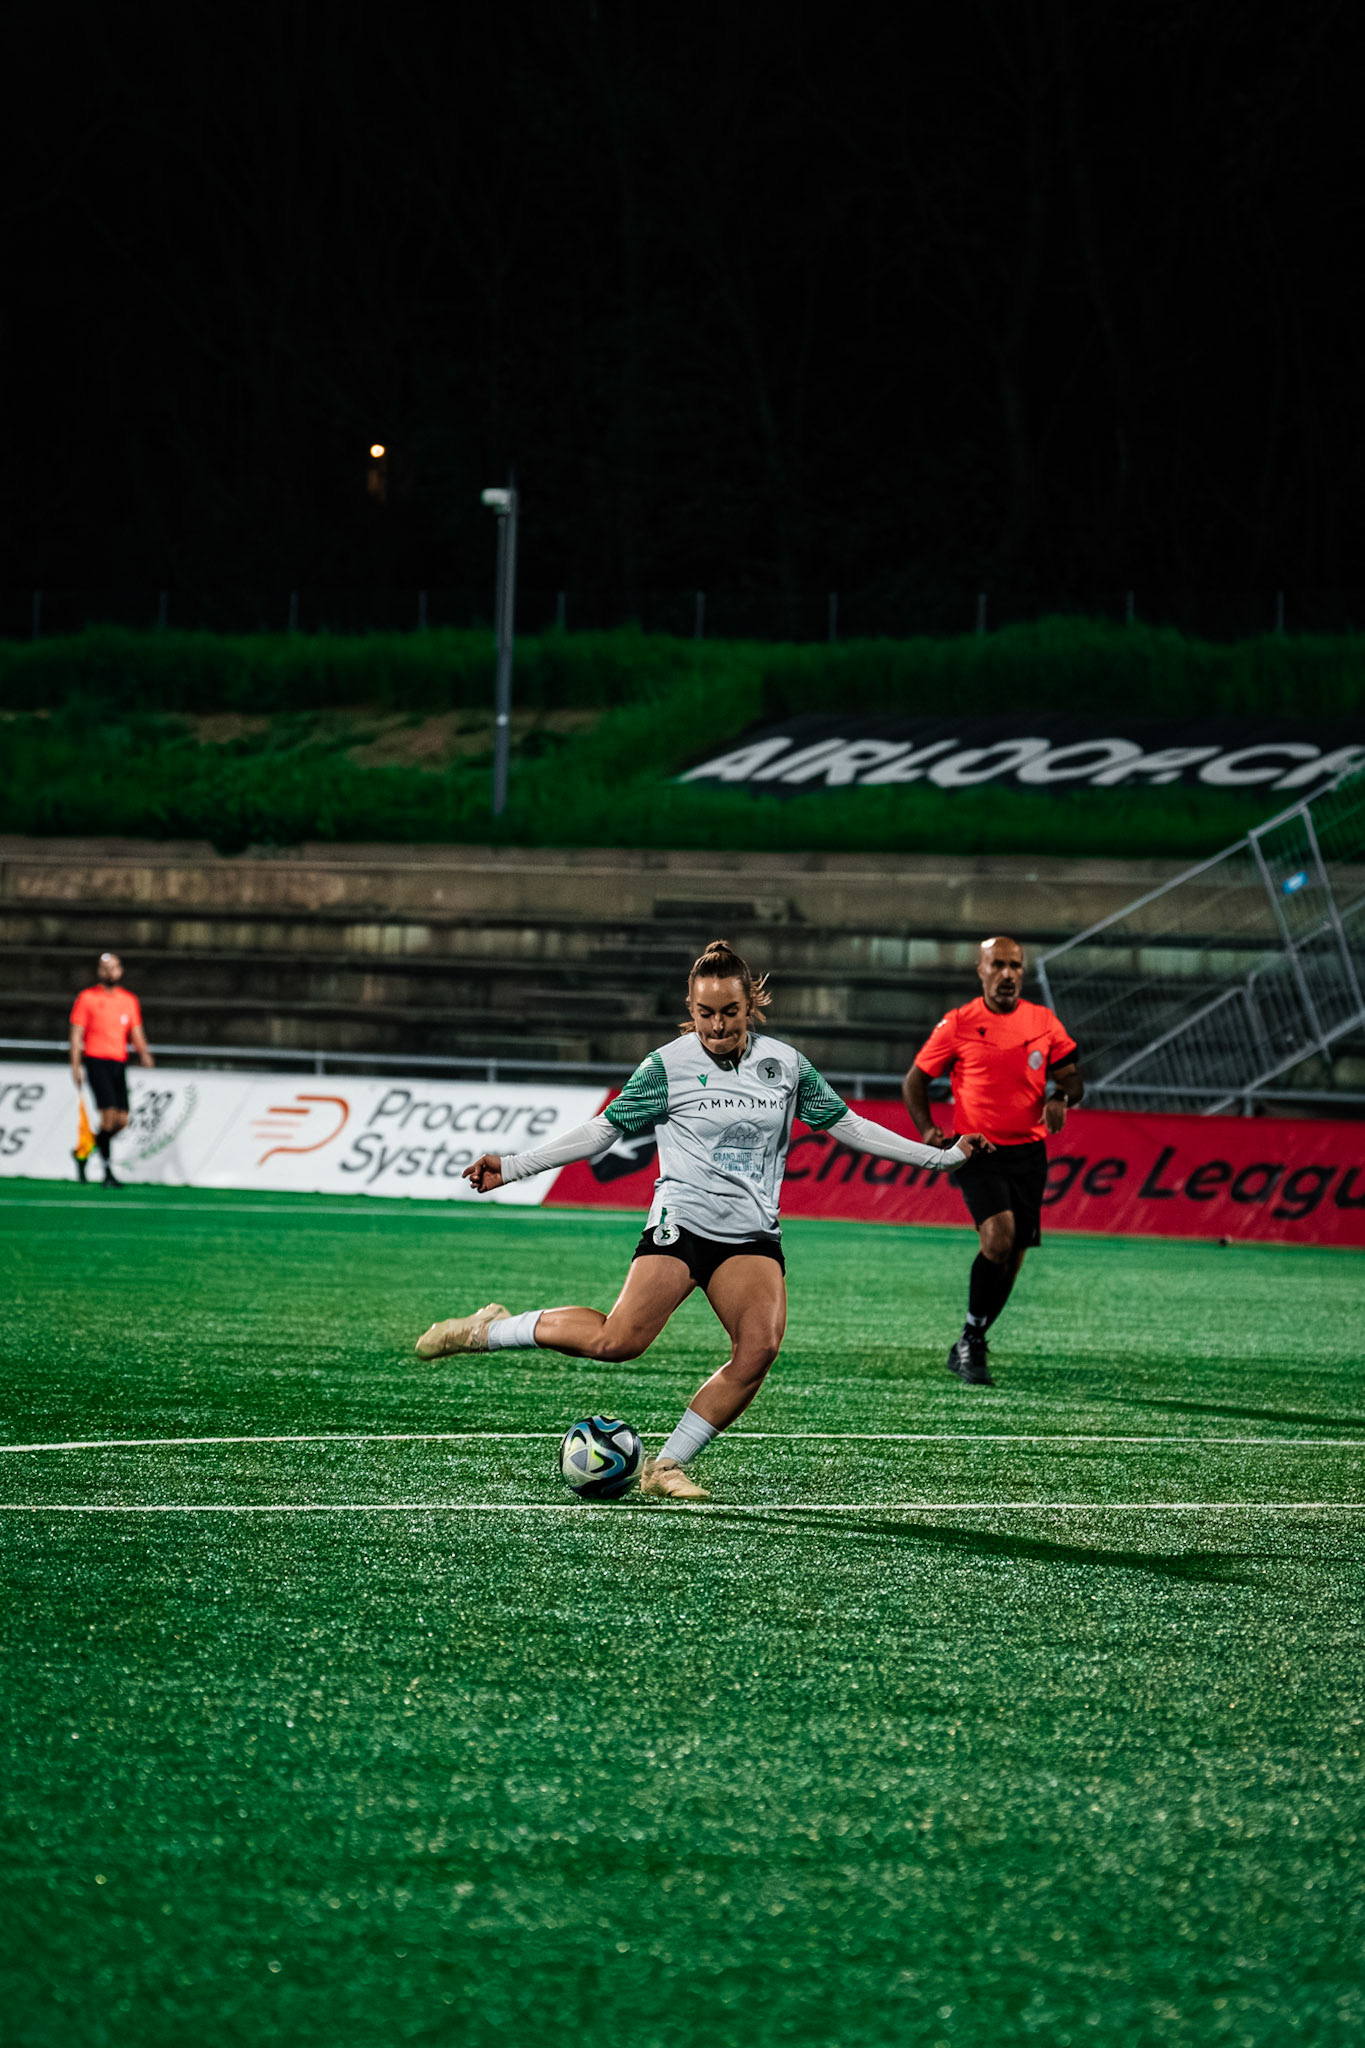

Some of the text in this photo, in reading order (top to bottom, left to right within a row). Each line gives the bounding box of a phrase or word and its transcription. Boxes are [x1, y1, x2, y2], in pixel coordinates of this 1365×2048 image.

[367, 1088, 558, 1136] Procare
[339, 1132, 517, 1185] Syste
[784, 1133, 1126, 1206] Chage
